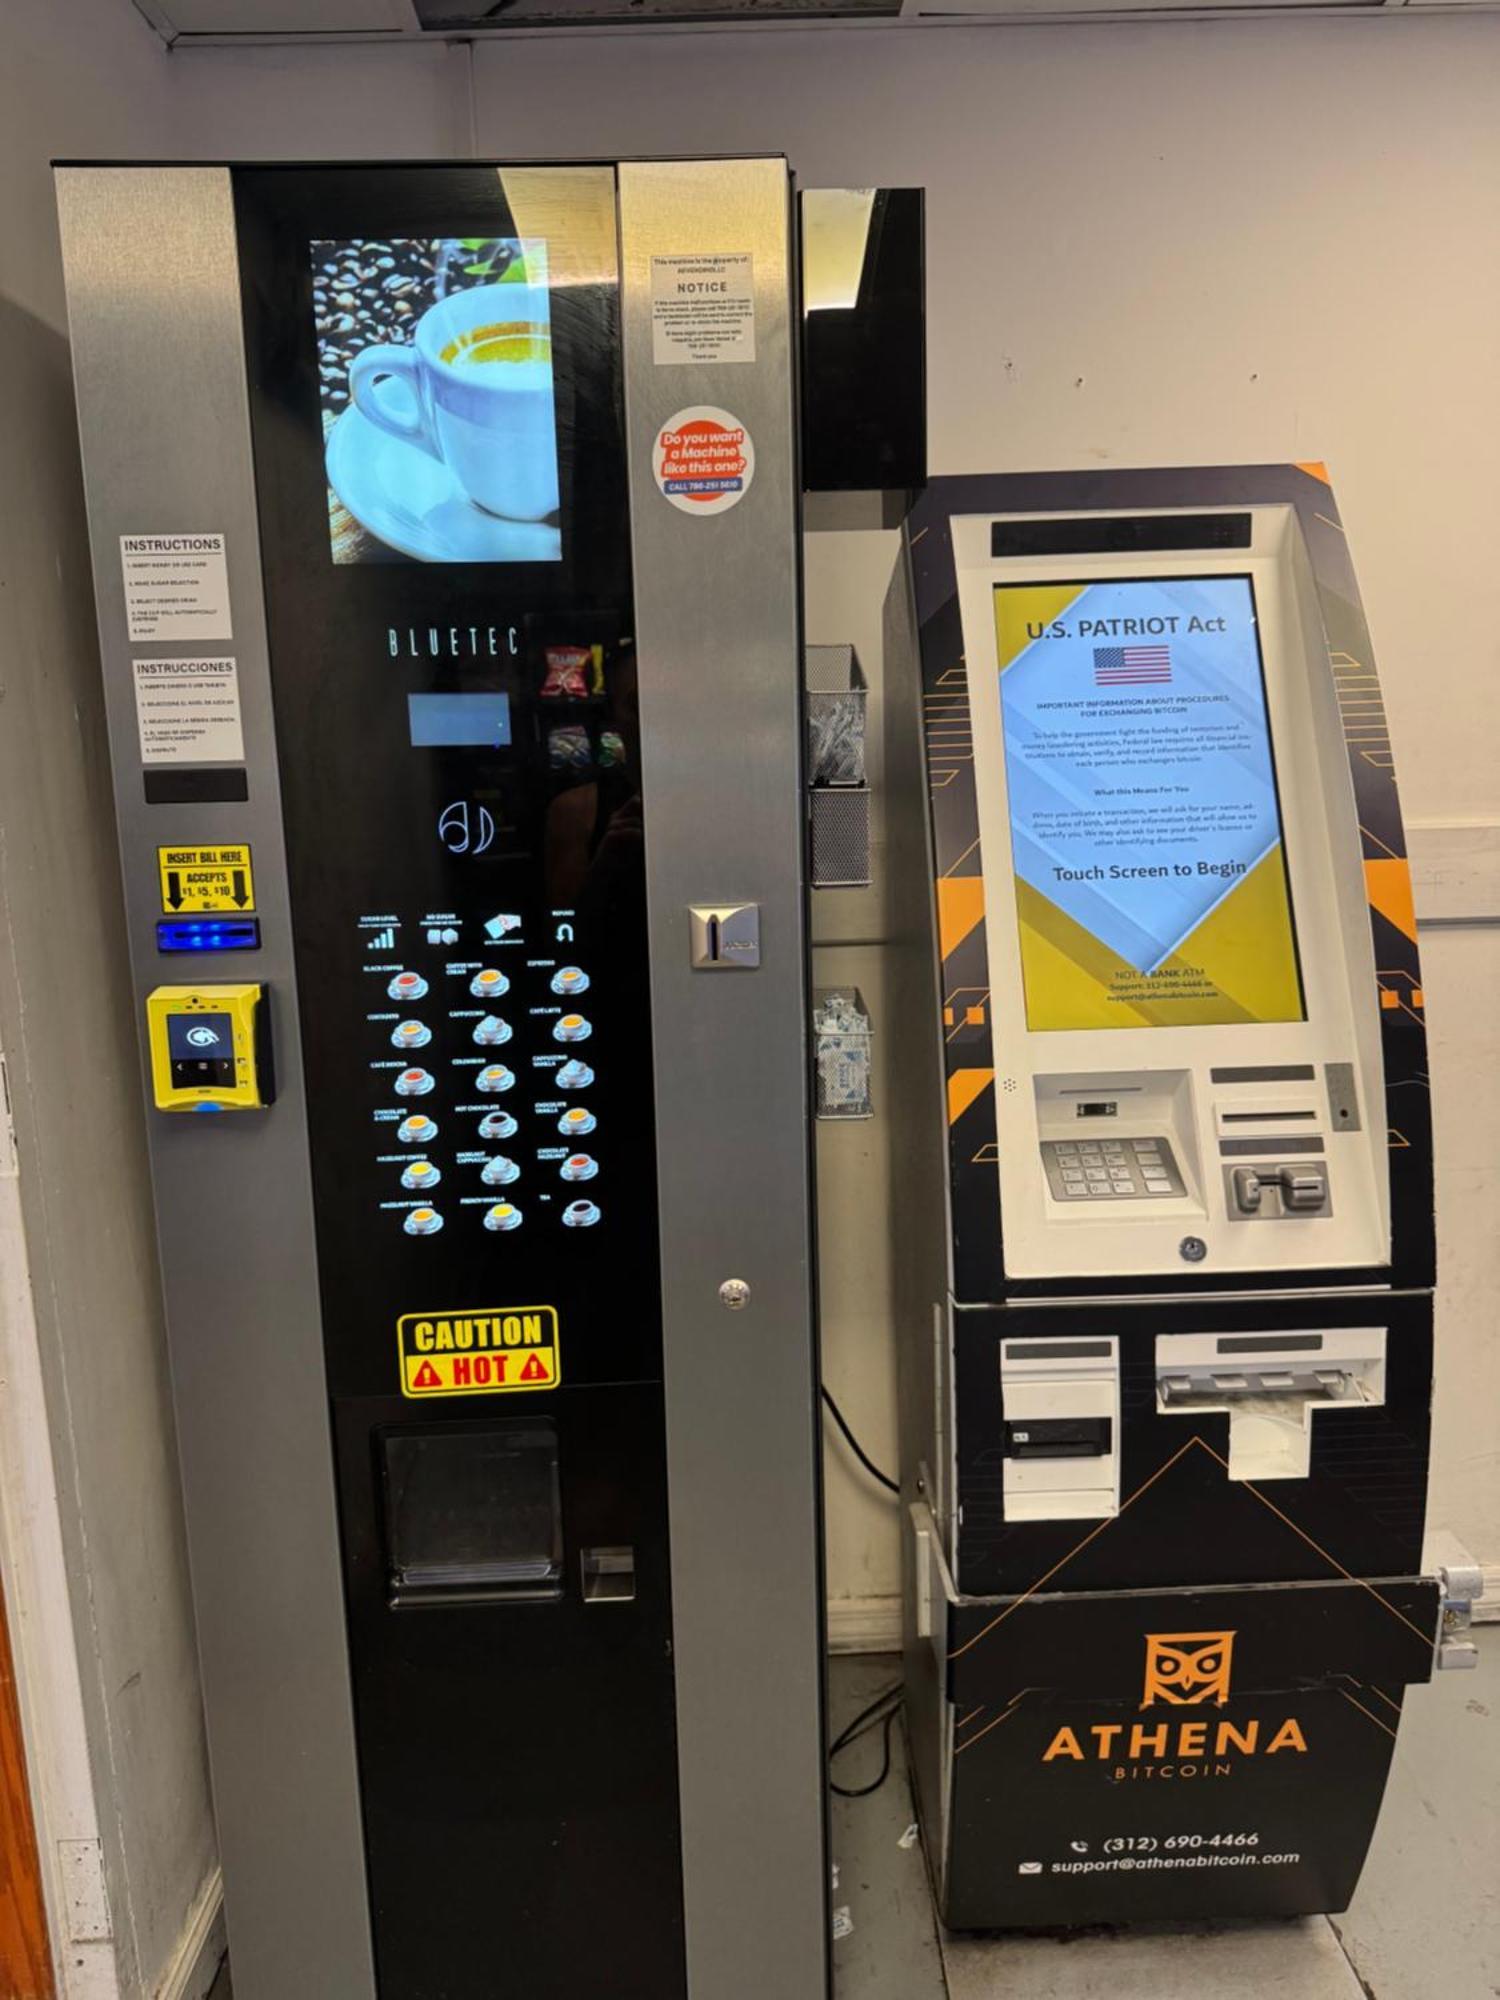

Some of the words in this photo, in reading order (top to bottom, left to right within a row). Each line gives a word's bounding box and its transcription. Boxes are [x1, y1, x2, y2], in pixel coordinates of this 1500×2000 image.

[678, 282, 728, 293] NOTICE
[664, 434, 681, 445] Do
[683, 434, 707, 446] you
[710, 431, 742, 442] want
[672, 451, 679, 459] a
[682, 446, 737, 458] Machine
[664, 462, 687, 474] like
[688, 460, 712, 472] this
[714, 460, 745, 471] one?
[124, 539, 220, 551] INSTRUCTIONS
[1026, 620, 1072, 640] U.S.
[1078, 616, 1180, 637] PATRIOT
[1187, 616, 1226, 634] Act
[389, 626, 518, 657] BLUETEC
[137, 662, 233, 674] INSTRUCCIONES
[1036, 701, 1084, 709] IMPORTANT
[1086, 699, 1144, 708] INFORMATION
[1145, 697, 1174, 705] ABOUT
[1176, 695, 1230, 703] PROCEDURES
[1099, 708, 1152, 717] EXCHANGING
[167, 852, 196, 864] INSERT
[200, 852, 216, 863] BILL
[221, 852, 242, 862] HERE
[187, 872, 227, 883] ACCEPTS
[1052, 866, 1105, 881] Touch
[1109, 864, 1169, 880] Screen
[1174, 864, 1192, 877] to
[1198, 860, 1246, 878] Begin
[214, 885, 230, 896] $10
[1150, 969, 1181, 978] BANK
[414, 1314, 542, 1352] CAUTION
[453, 1354, 508, 1386] HOT
[1040, 1718, 1308, 1762] ATHENA
[1114, 1764, 1232, 1780] BITCOIN
[1102, 1836, 1158, 1854] (312)
[1164, 1833, 1259, 1850] 690-4466
[1051, 1851, 1300, 1874] support@athenabitcoin.com
